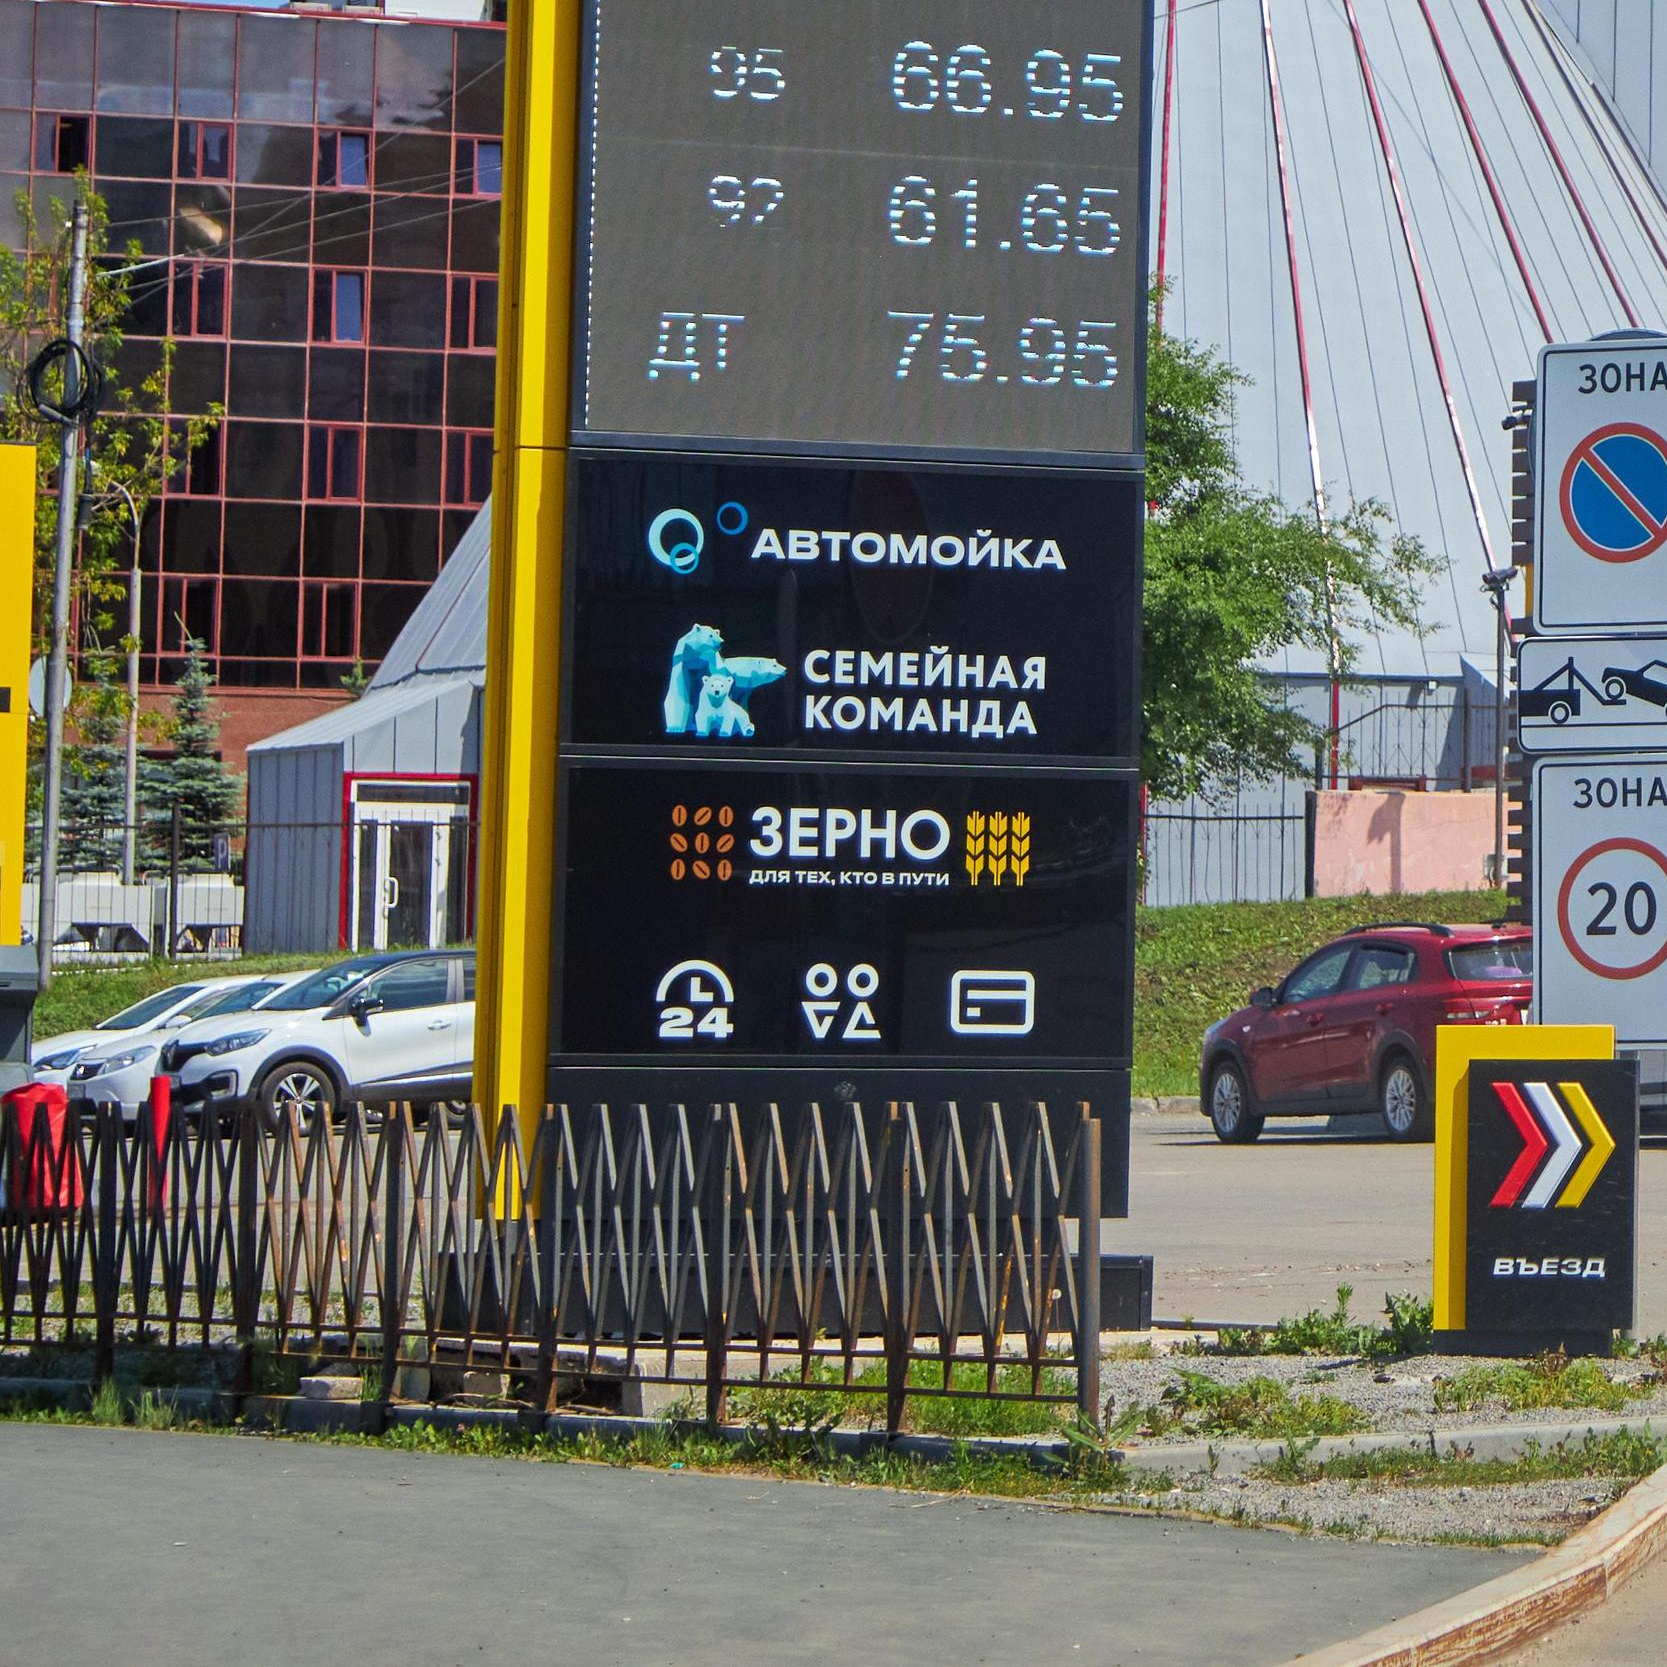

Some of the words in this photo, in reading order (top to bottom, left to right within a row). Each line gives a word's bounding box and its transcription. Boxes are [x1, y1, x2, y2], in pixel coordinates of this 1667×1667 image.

[710, 46, 786, 100] 95
[893, 41, 1123, 122] 66.95
[889, 176, 1120, 255] 61.65
[649, 312, 744, 380] ДТ
[888, 311, 1118, 387] 75.95
[751, 528, 1066, 570] АВТОМОЙКА
[803, 645, 1046, 690] СЕМЕЙНАЯ
[803, 694, 1038, 738] КОМАНДА
[749, 806, 950, 860] ЗЕРНО
[749, 869, 790, 885] ДЛЯ
[839, 872, 878, 886] КТО
[898, 874, 949, 886] ПУТИ
[1585, 881, 1657, 936] 20
[659, 1008, 734, 1038] 24
[1493, 1257, 1607, 1278] ВЪЕЗД
